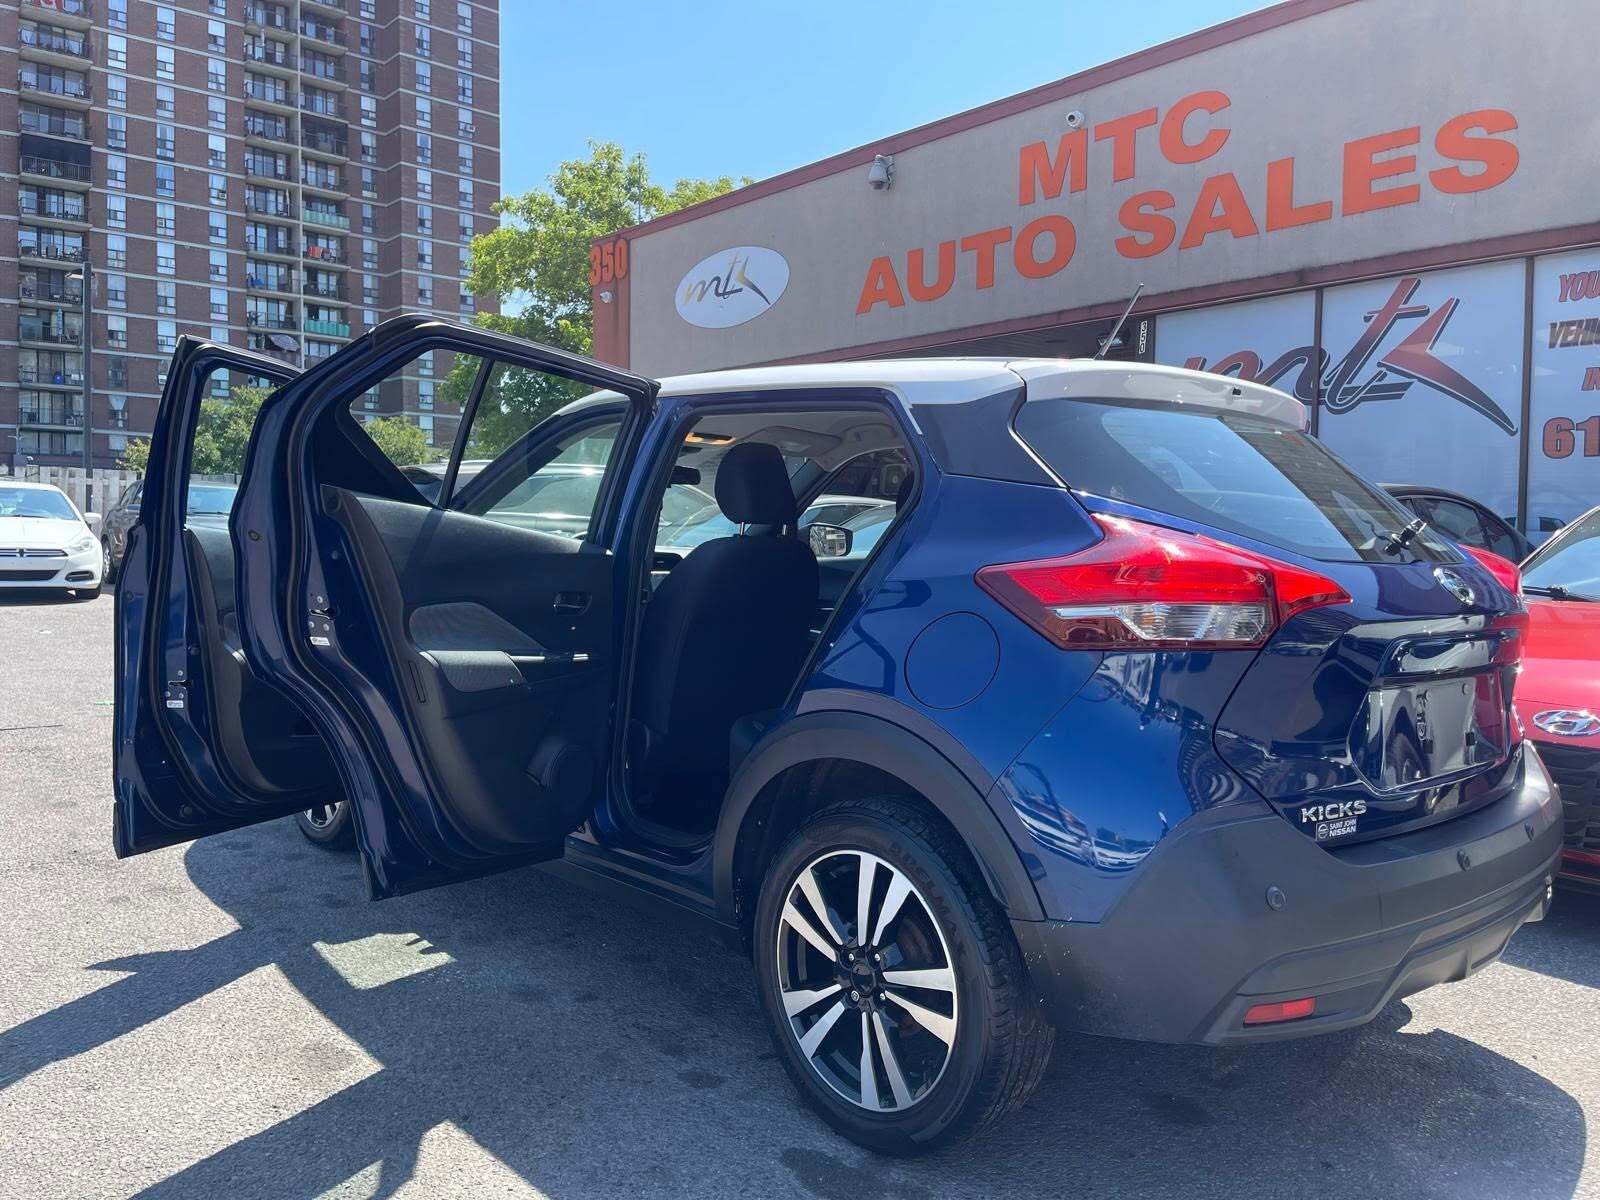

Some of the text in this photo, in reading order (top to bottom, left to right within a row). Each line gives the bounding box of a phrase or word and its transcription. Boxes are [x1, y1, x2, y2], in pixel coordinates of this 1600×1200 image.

[1018, 90, 1231, 206] MTC
[856, 109, 1520, 315] AUTO SALES
[590, 238, 629, 287] 350
[1139, 320, 1148, 354] 350
[1301, 799, 1367, 823] KICKS
[1329, 818, 1357, 830] SAINT JOHN
[1329, 825, 1357, 837] NISSAN
